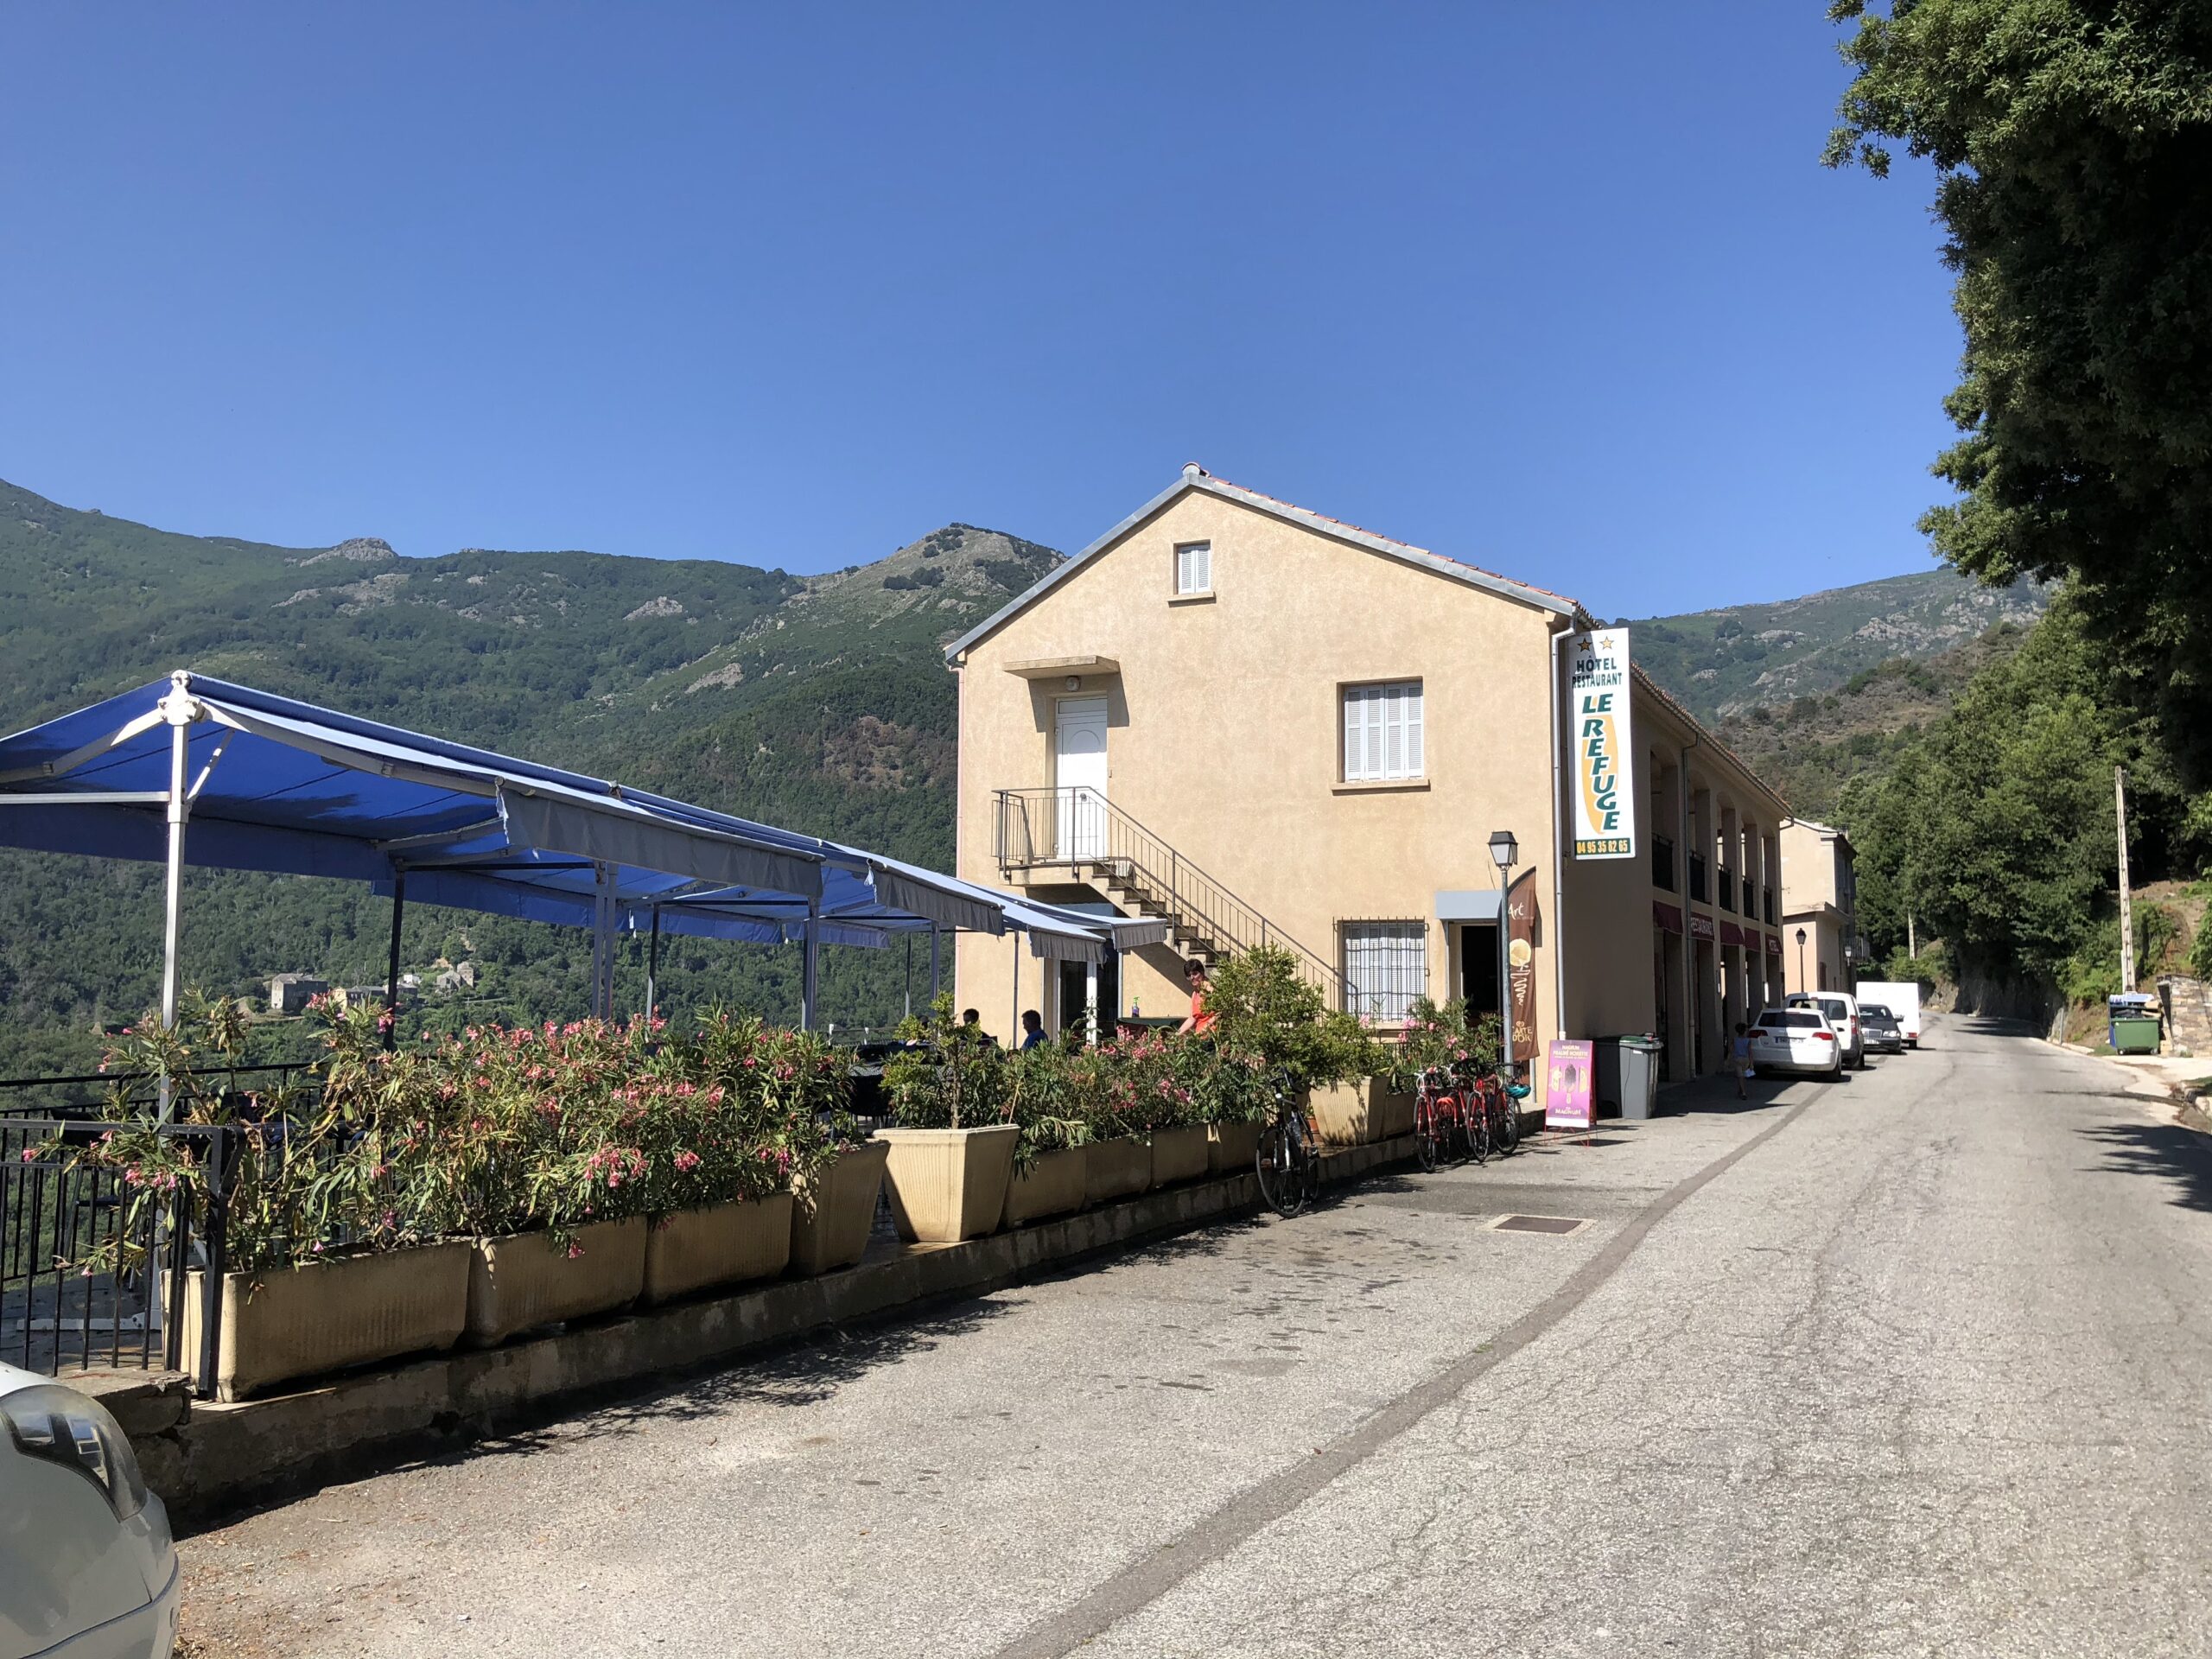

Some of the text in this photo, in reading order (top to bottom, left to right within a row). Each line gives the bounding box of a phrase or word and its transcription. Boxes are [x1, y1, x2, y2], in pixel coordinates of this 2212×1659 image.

[1576, 655, 1617, 672] HÔTEL
[1572, 672, 1622, 689] RESTAURANT
[1582, 693, 1613, 714] LE
[1582, 719, 1620, 830] REFUGE
[1577, 839, 1628, 854] 04 95 35 82 65
[1512, 1026, 1533, 1035] ARTE
